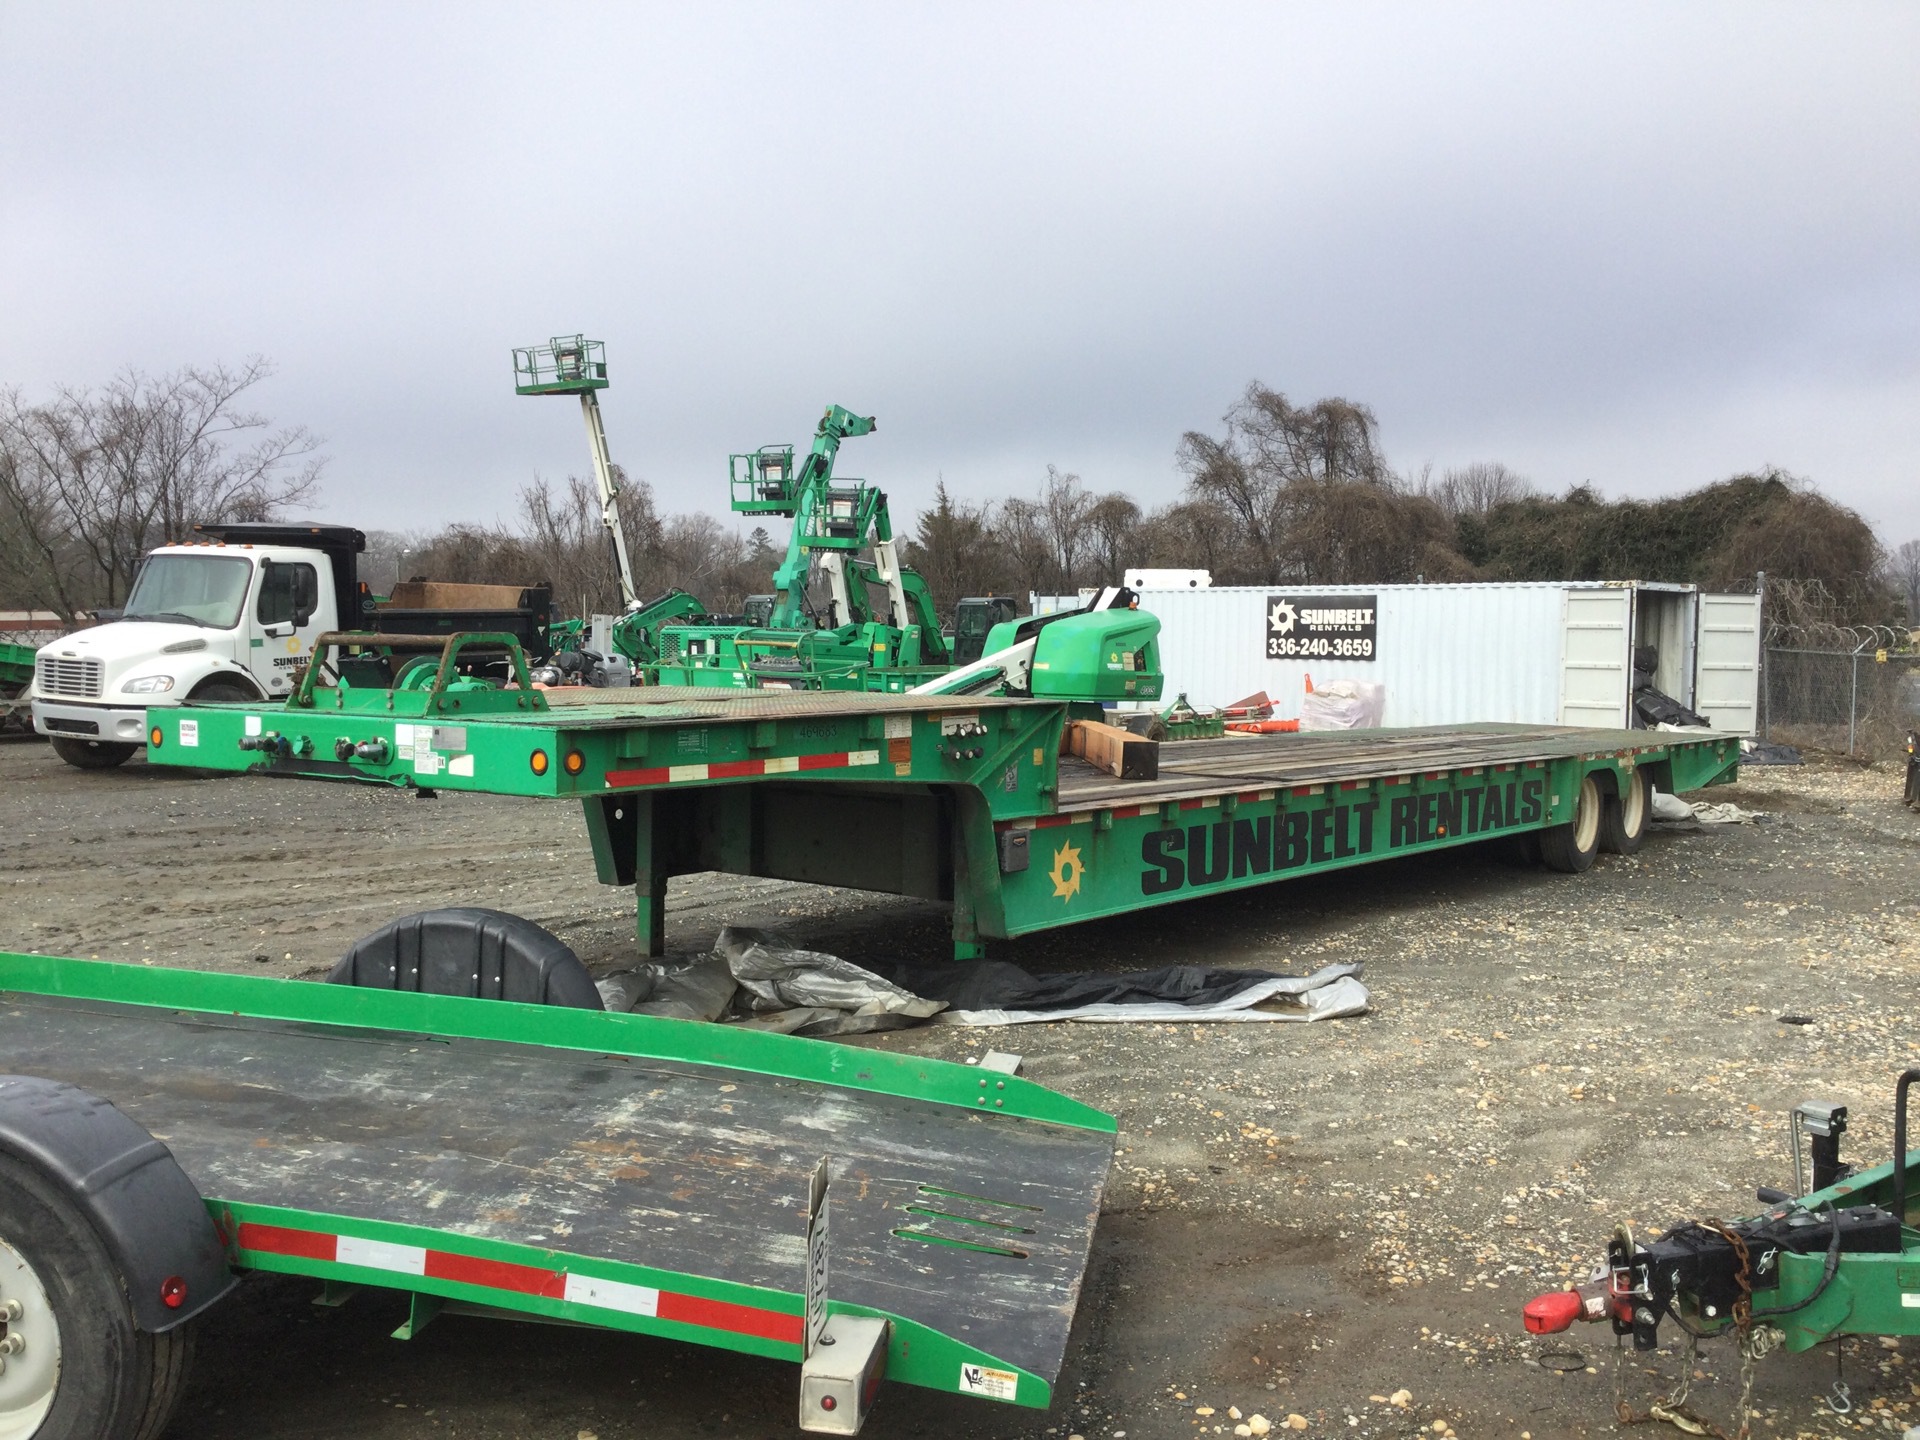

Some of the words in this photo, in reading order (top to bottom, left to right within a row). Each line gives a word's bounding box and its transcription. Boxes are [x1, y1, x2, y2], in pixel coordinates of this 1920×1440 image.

[1300, 609, 1374, 625] SUNBELT
[1268, 638, 1373, 656] 336-240-3659
[1141, 801, 1380, 896] SUNBELT
[1390, 779, 1543, 848] RENTALS
